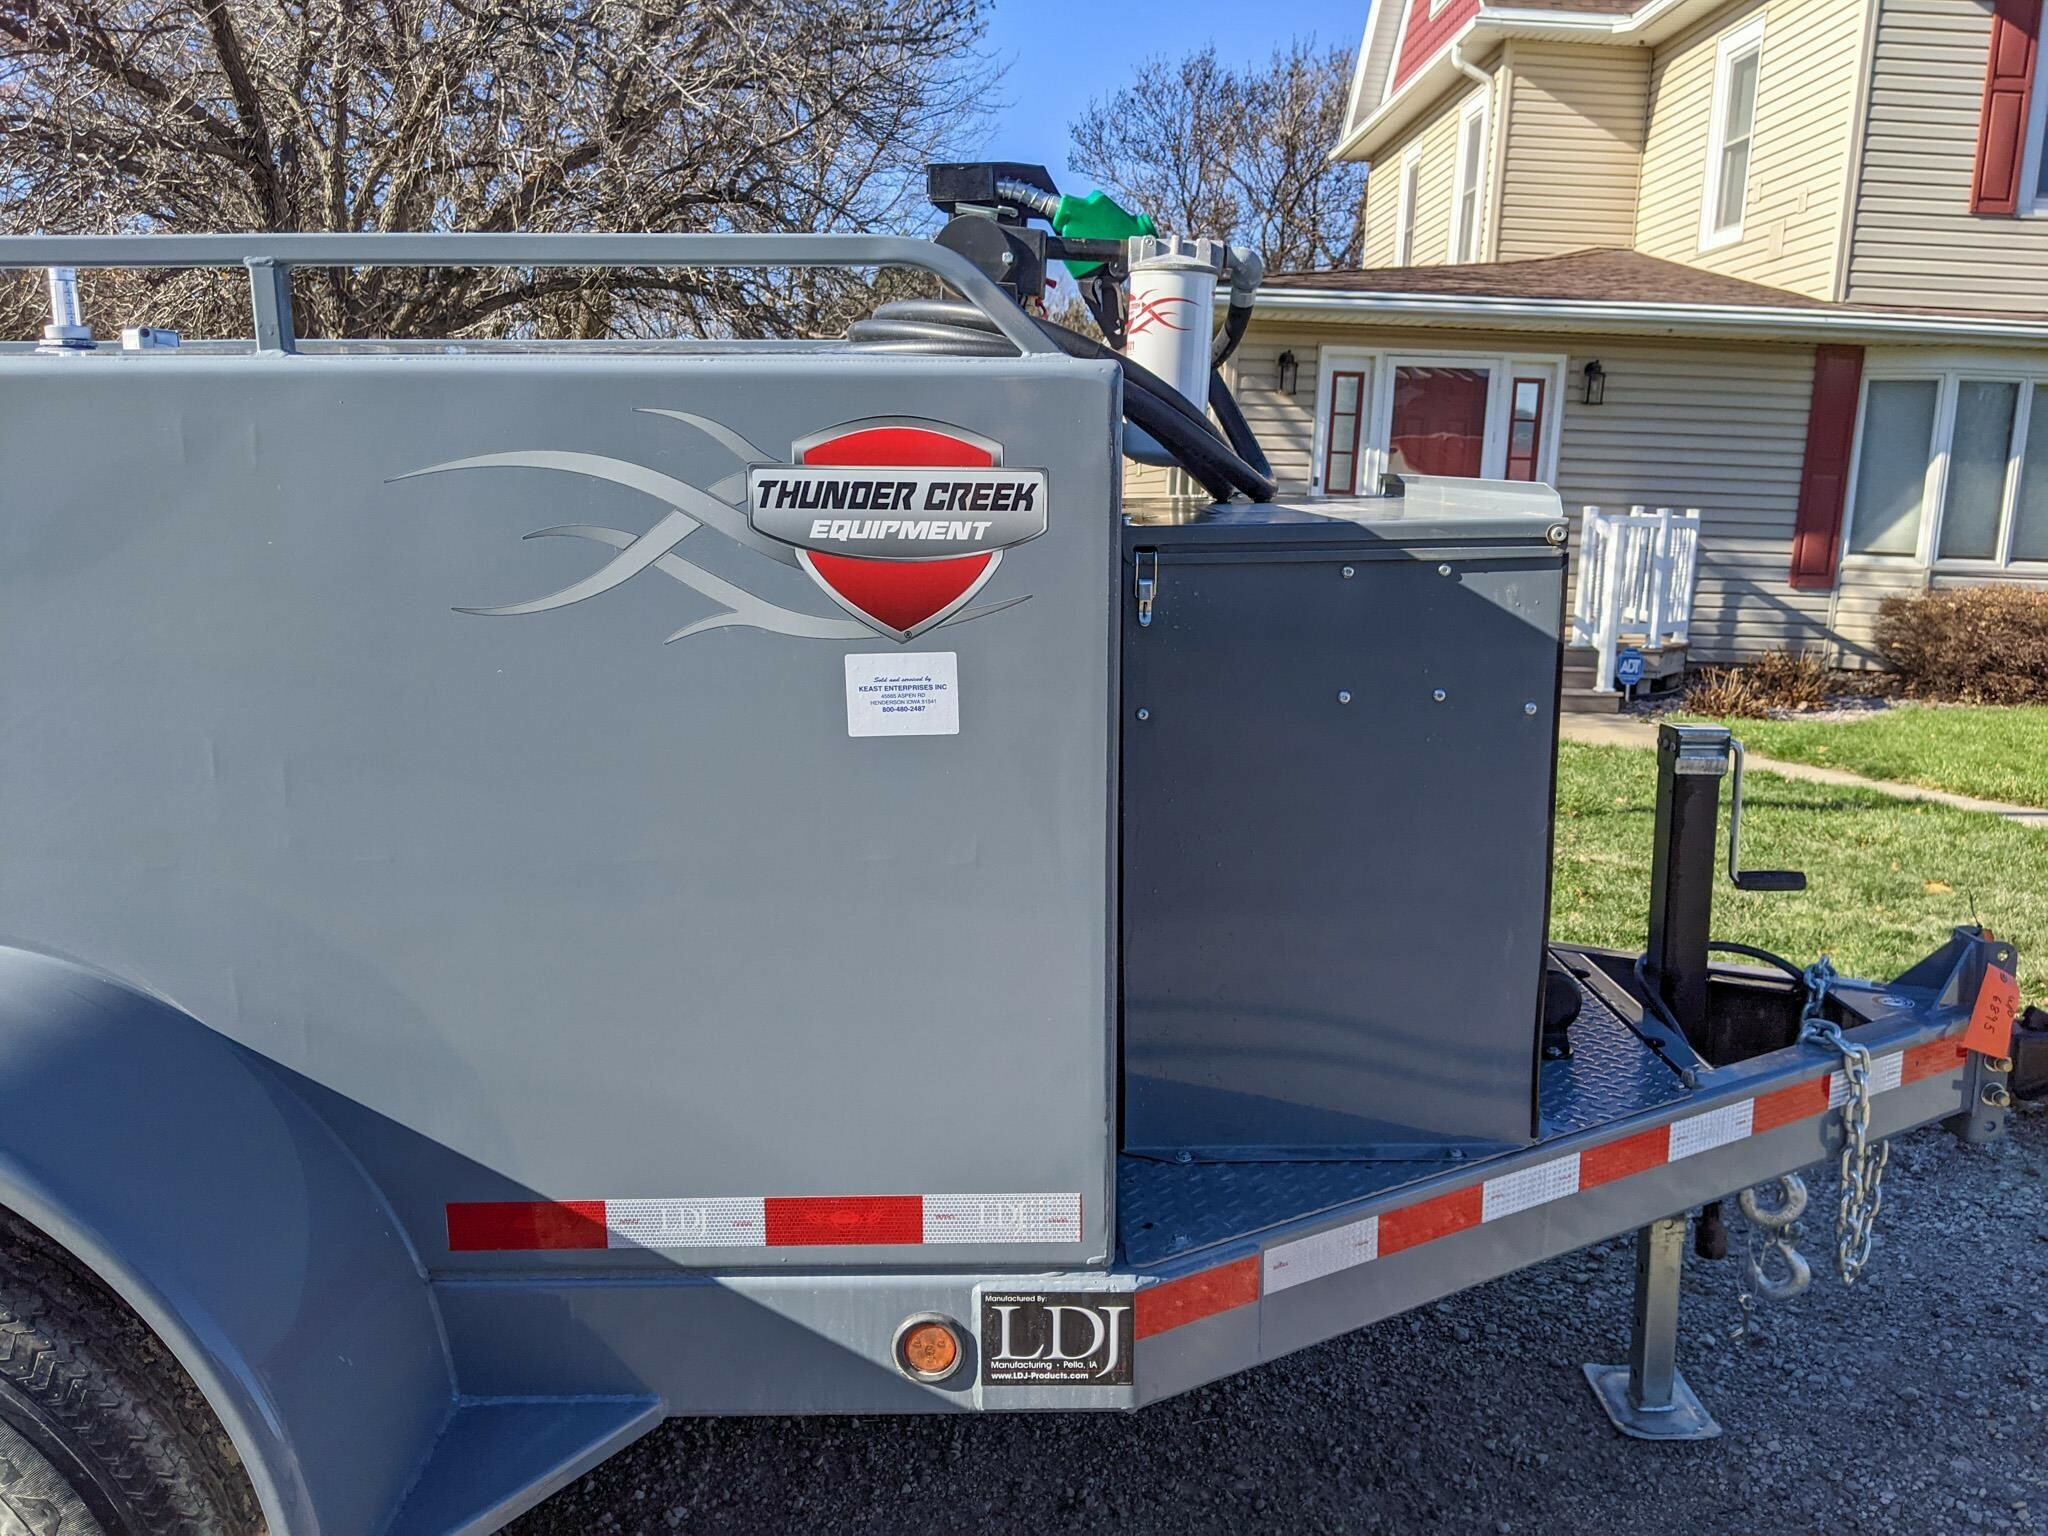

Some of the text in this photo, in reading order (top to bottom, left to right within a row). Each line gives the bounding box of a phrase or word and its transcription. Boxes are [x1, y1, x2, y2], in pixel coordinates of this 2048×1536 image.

[757, 480, 1038, 511] THUNDER CREEK
[809, 520, 992, 541] EQUIPMENT
[1620, 659, 1641, 673] ADT
[925, 675, 932, 683] by
[884, 684, 934, 692] ENTERPRISES
[1036, 1295, 1047, 1303] By:
[991, 1305, 1130, 1378] LDJ
[990, 1361, 1053, 1370] Manufacturing
[991, 1371, 1089, 1380] www.LDJ-Products.com
